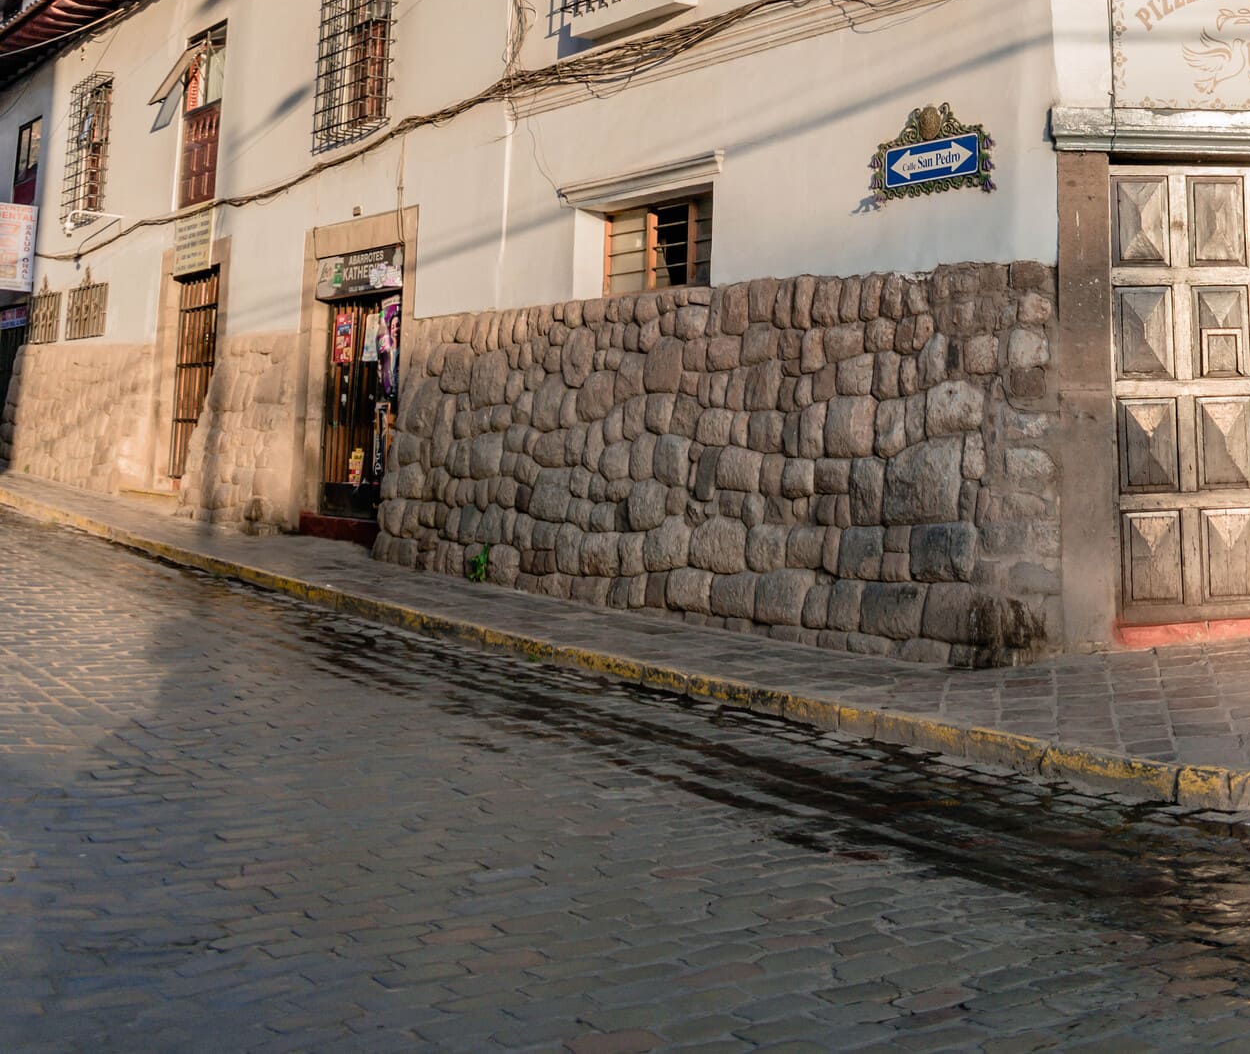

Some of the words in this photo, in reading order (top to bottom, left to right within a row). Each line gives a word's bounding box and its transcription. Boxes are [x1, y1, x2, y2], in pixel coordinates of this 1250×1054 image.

[917, 156, 933, 169] San
[935, 151, 960, 165] Pedro
[0, 211, 36, 222] ENTAL
[348, 250, 385, 265] ABARROTES
